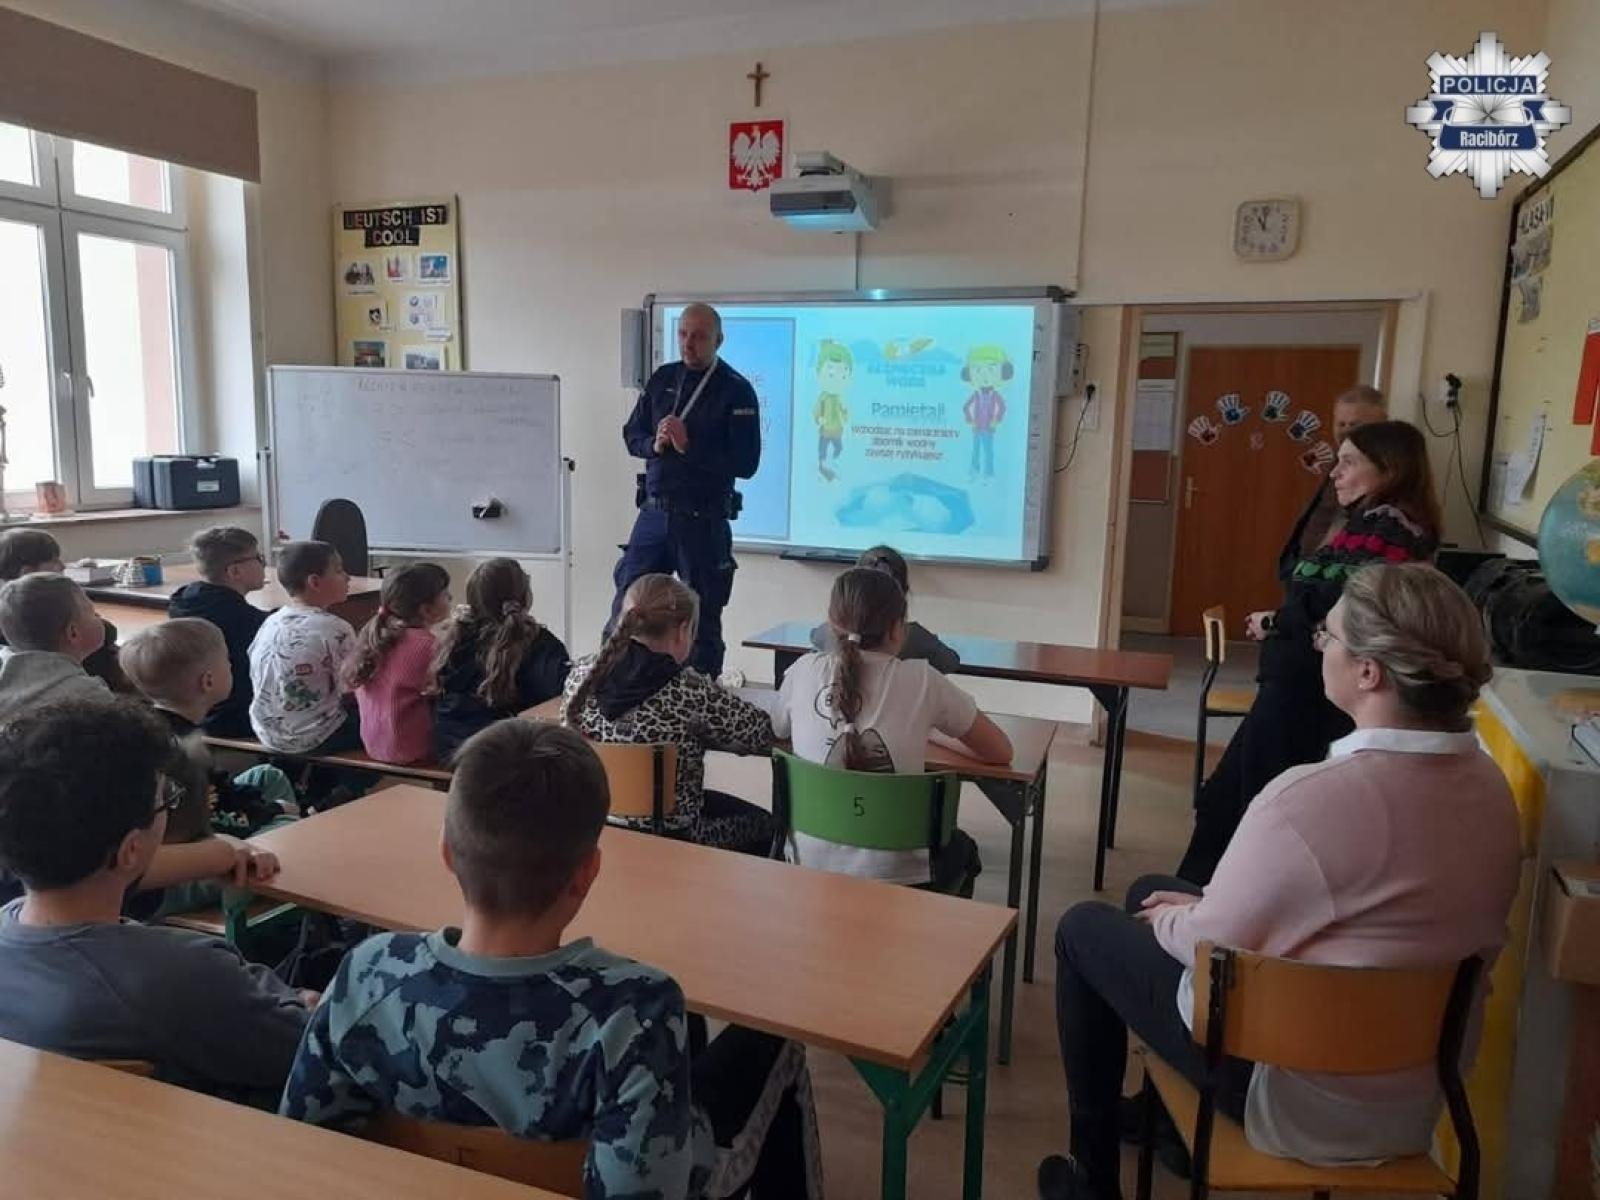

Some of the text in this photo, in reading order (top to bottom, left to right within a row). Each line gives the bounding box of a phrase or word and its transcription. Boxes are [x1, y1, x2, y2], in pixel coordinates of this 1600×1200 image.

[421, 207, 445, 223] IST
[372, 229, 416, 245] COOL
[854, 796, 865, 817] 5
